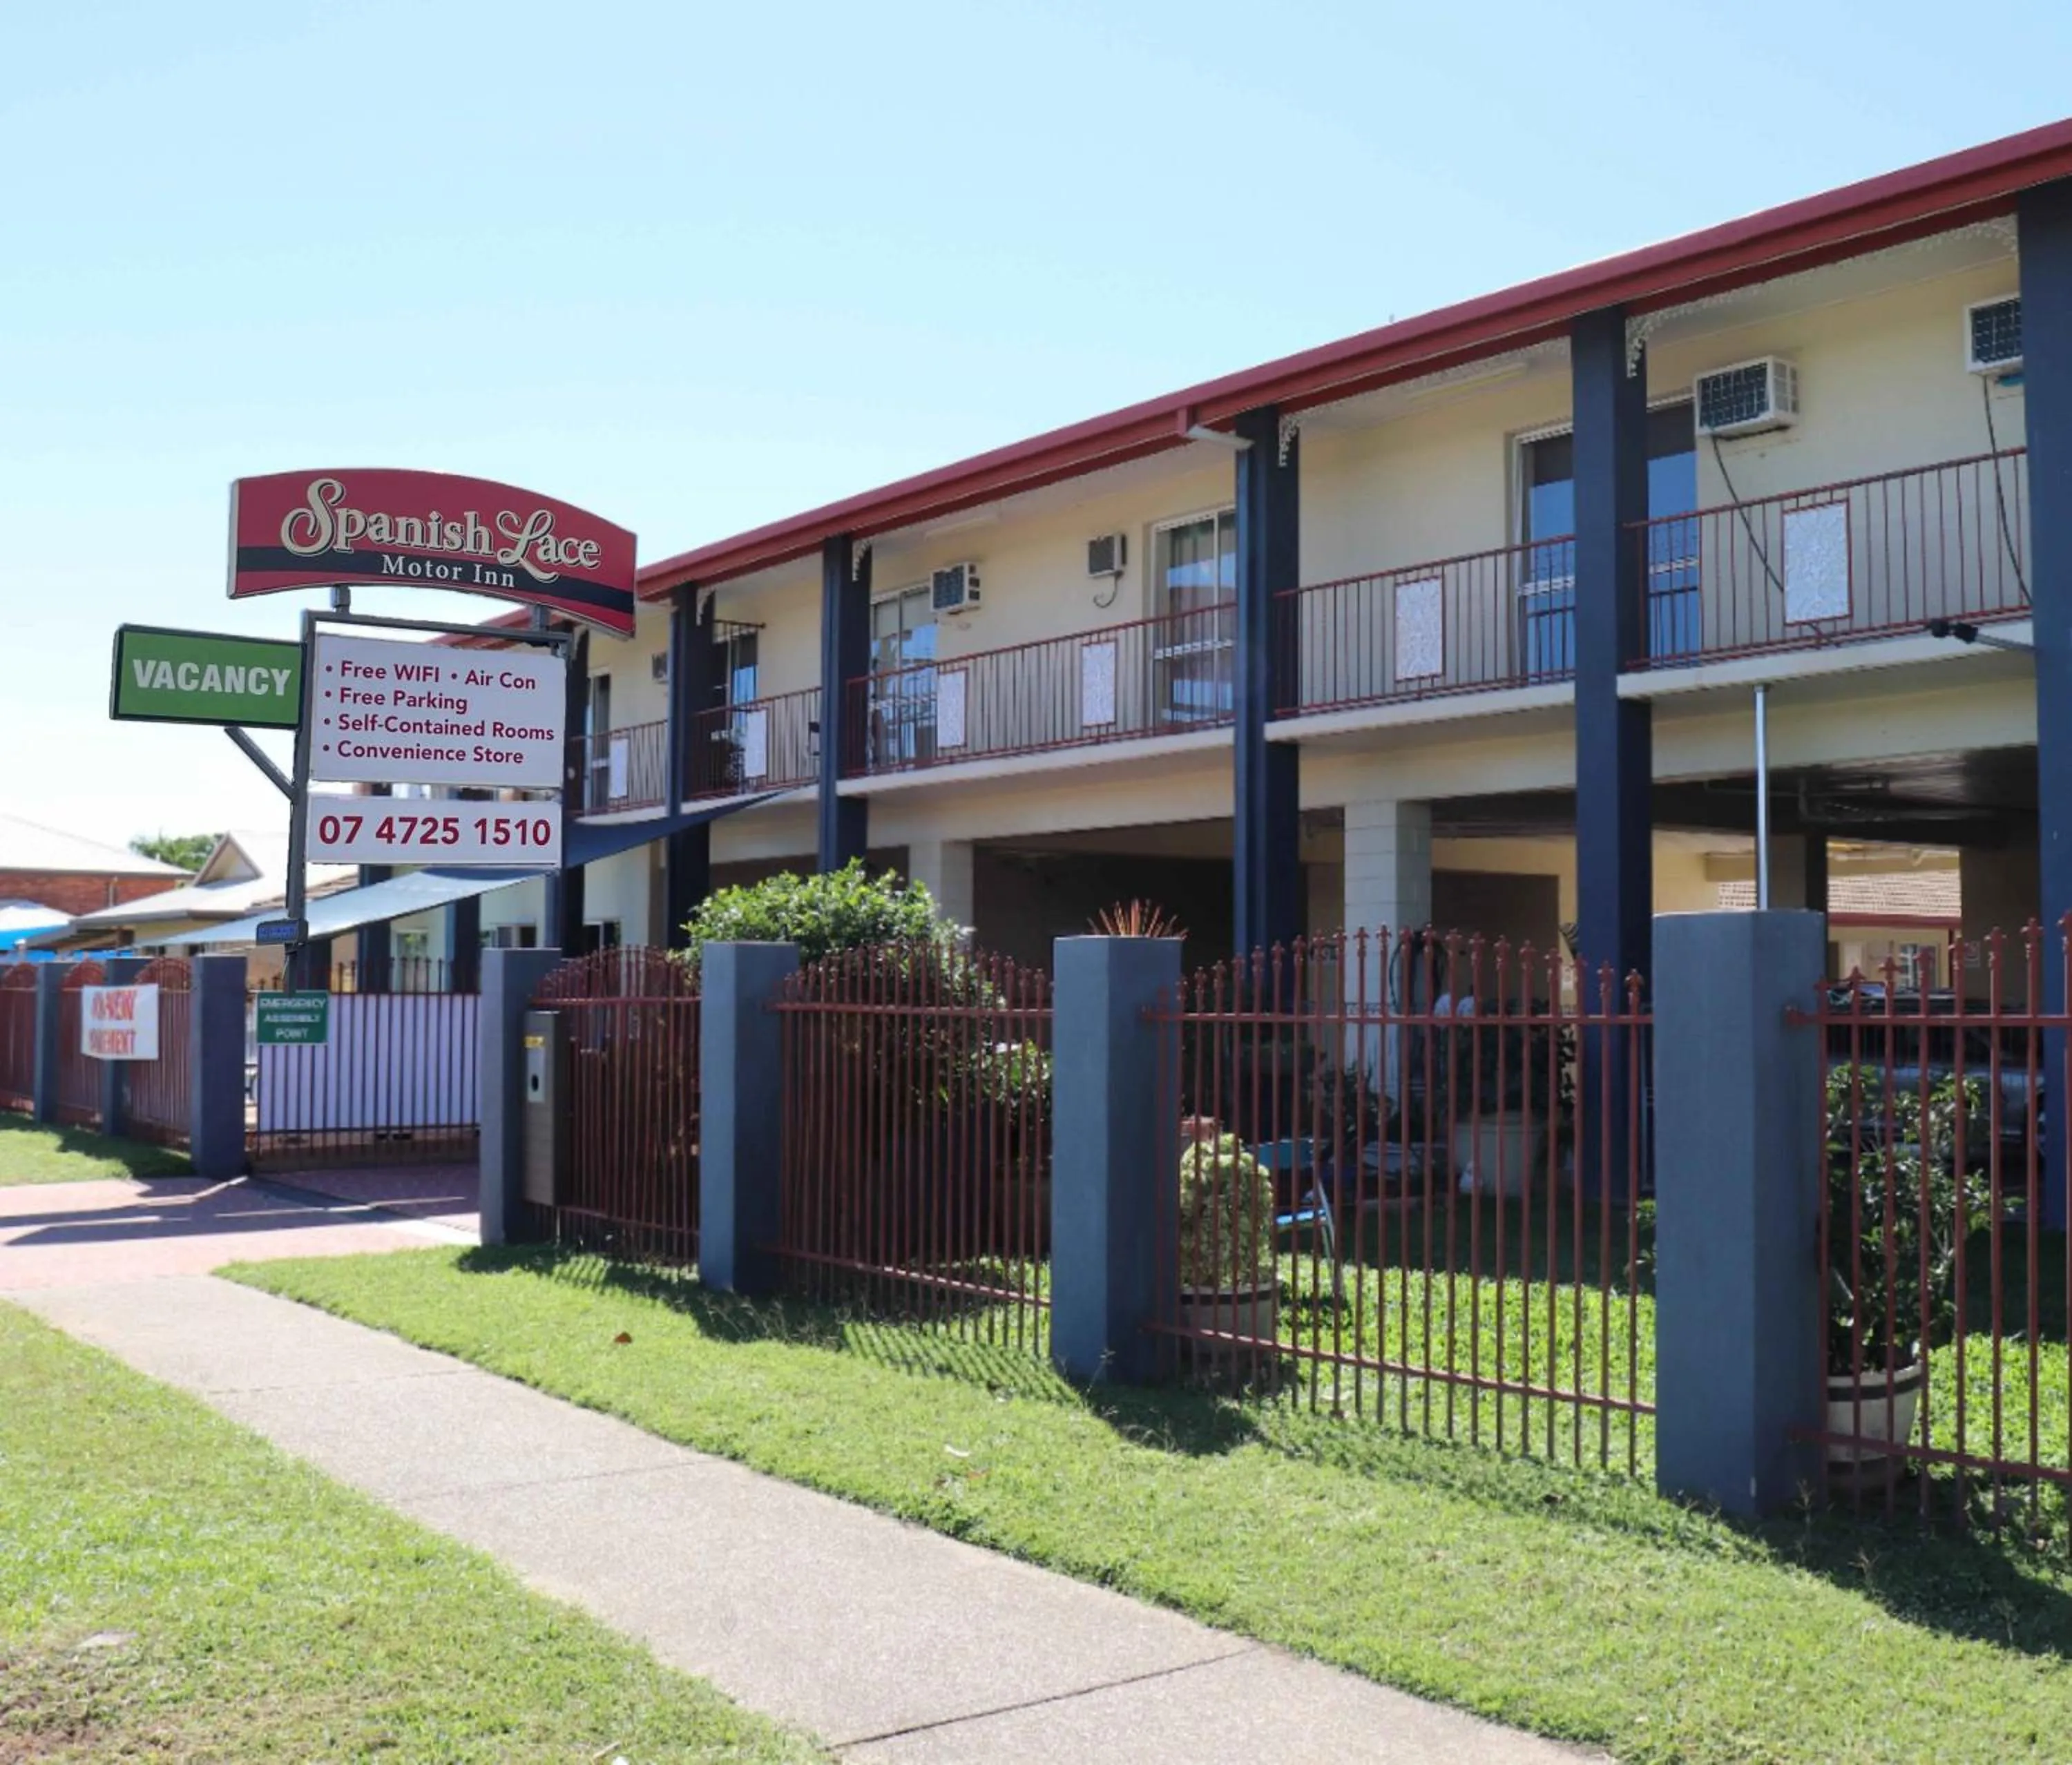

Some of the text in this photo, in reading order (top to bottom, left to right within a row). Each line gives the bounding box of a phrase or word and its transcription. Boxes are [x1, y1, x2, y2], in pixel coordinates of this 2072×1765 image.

[281, 479, 602, 583] Spanish Lace
[381, 555, 515, 588] Motor Inn
[133, 659, 291, 696] VACANCY
[340, 661, 536, 689] Free WIFI Air Con
[339, 688, 468, 714] Free Parking
[338, 714, 554, 740] Self-Contained Rooms
[337, 740, 524, 764] Convenience Store
[318, 815, 551, 847] 07 4725 1510
[260, 997, 326, 1008] EMERGENCY
[276, 1028, 309, 1039] POINT
